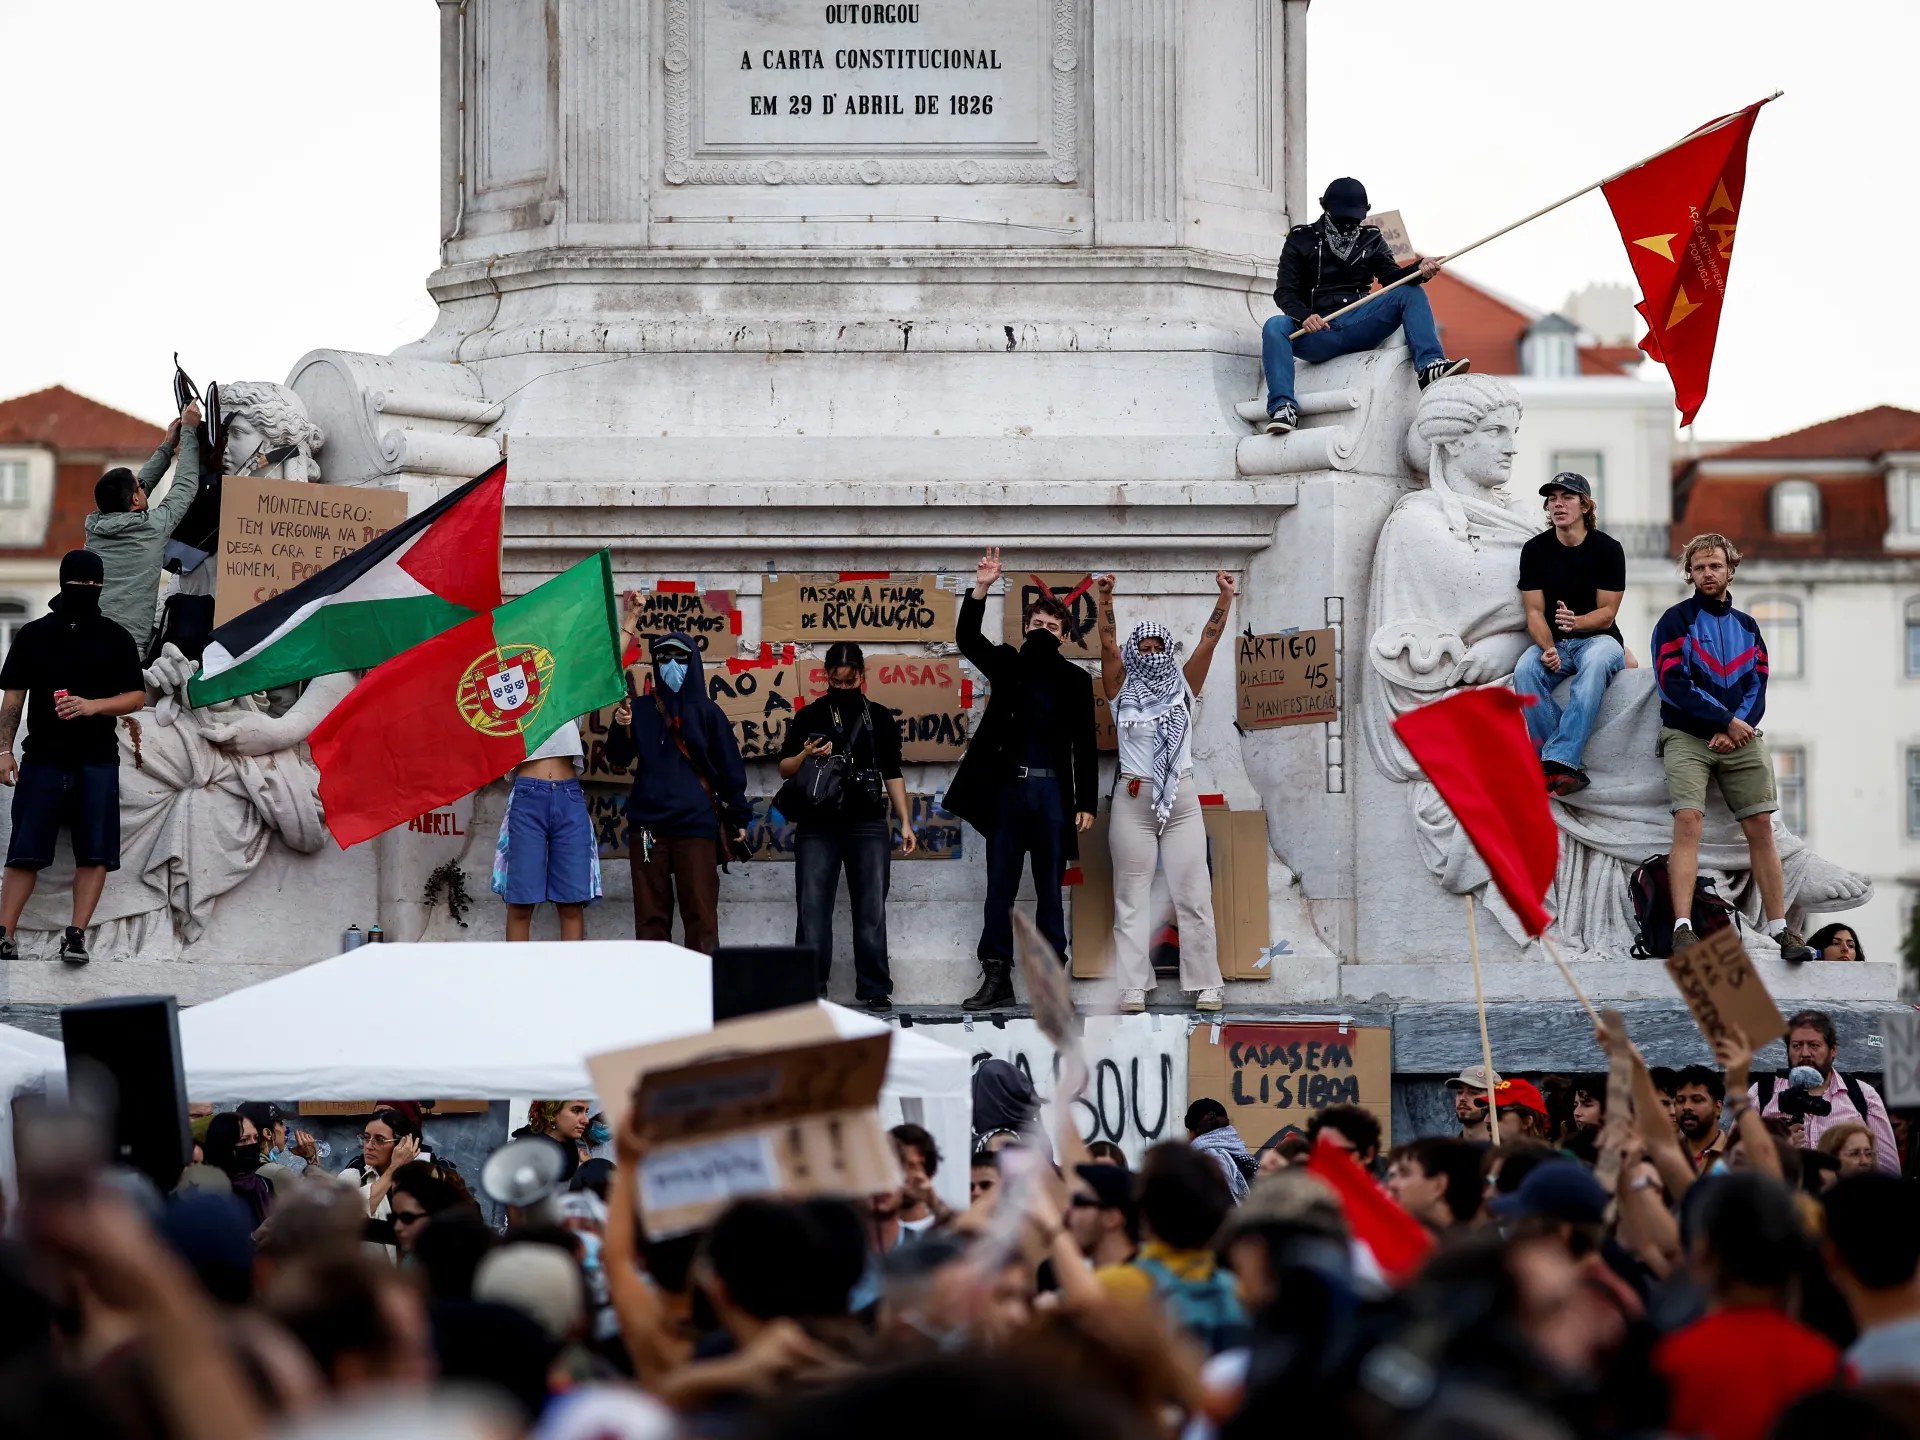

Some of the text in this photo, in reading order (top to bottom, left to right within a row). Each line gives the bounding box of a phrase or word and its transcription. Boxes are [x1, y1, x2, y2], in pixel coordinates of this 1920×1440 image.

[825, 4, 920, 24] OUTORGOU
[740, 48, 1002, 70] A CARTA CONSTITUCIONAL
[750, 95, 778, 116] EM
[789, 95, 812, 116] 29
[845, 95, 904, 116] ABRIL
[915, 95, 939, 115] DE
[950, 94, 994, 116] 1826
[1689, 243, 1712, 290] PORTUGAL
[257, 494, 372, 522] MONTENEGRO:
[237, 517, 263, 535] TEM
[270, 521, 330, 540] VERGONHA
[338, 526, 356, 542] NA
[226, 541, 262, 555] DESSA
[271, 544, 304, 558] CARA
[315, 547, 323, 558] E
[643, 593, 704, 614] AINDA
[800, 586, 857, 603] PASSAR
[861, 586, 873, 604] A
[801, 602, 936, 631] DE REVOLUÇÃO
[1240, 636, 1316, 665] ARTIGO
[1240, 663, 1329, 689] DIREITO 45
